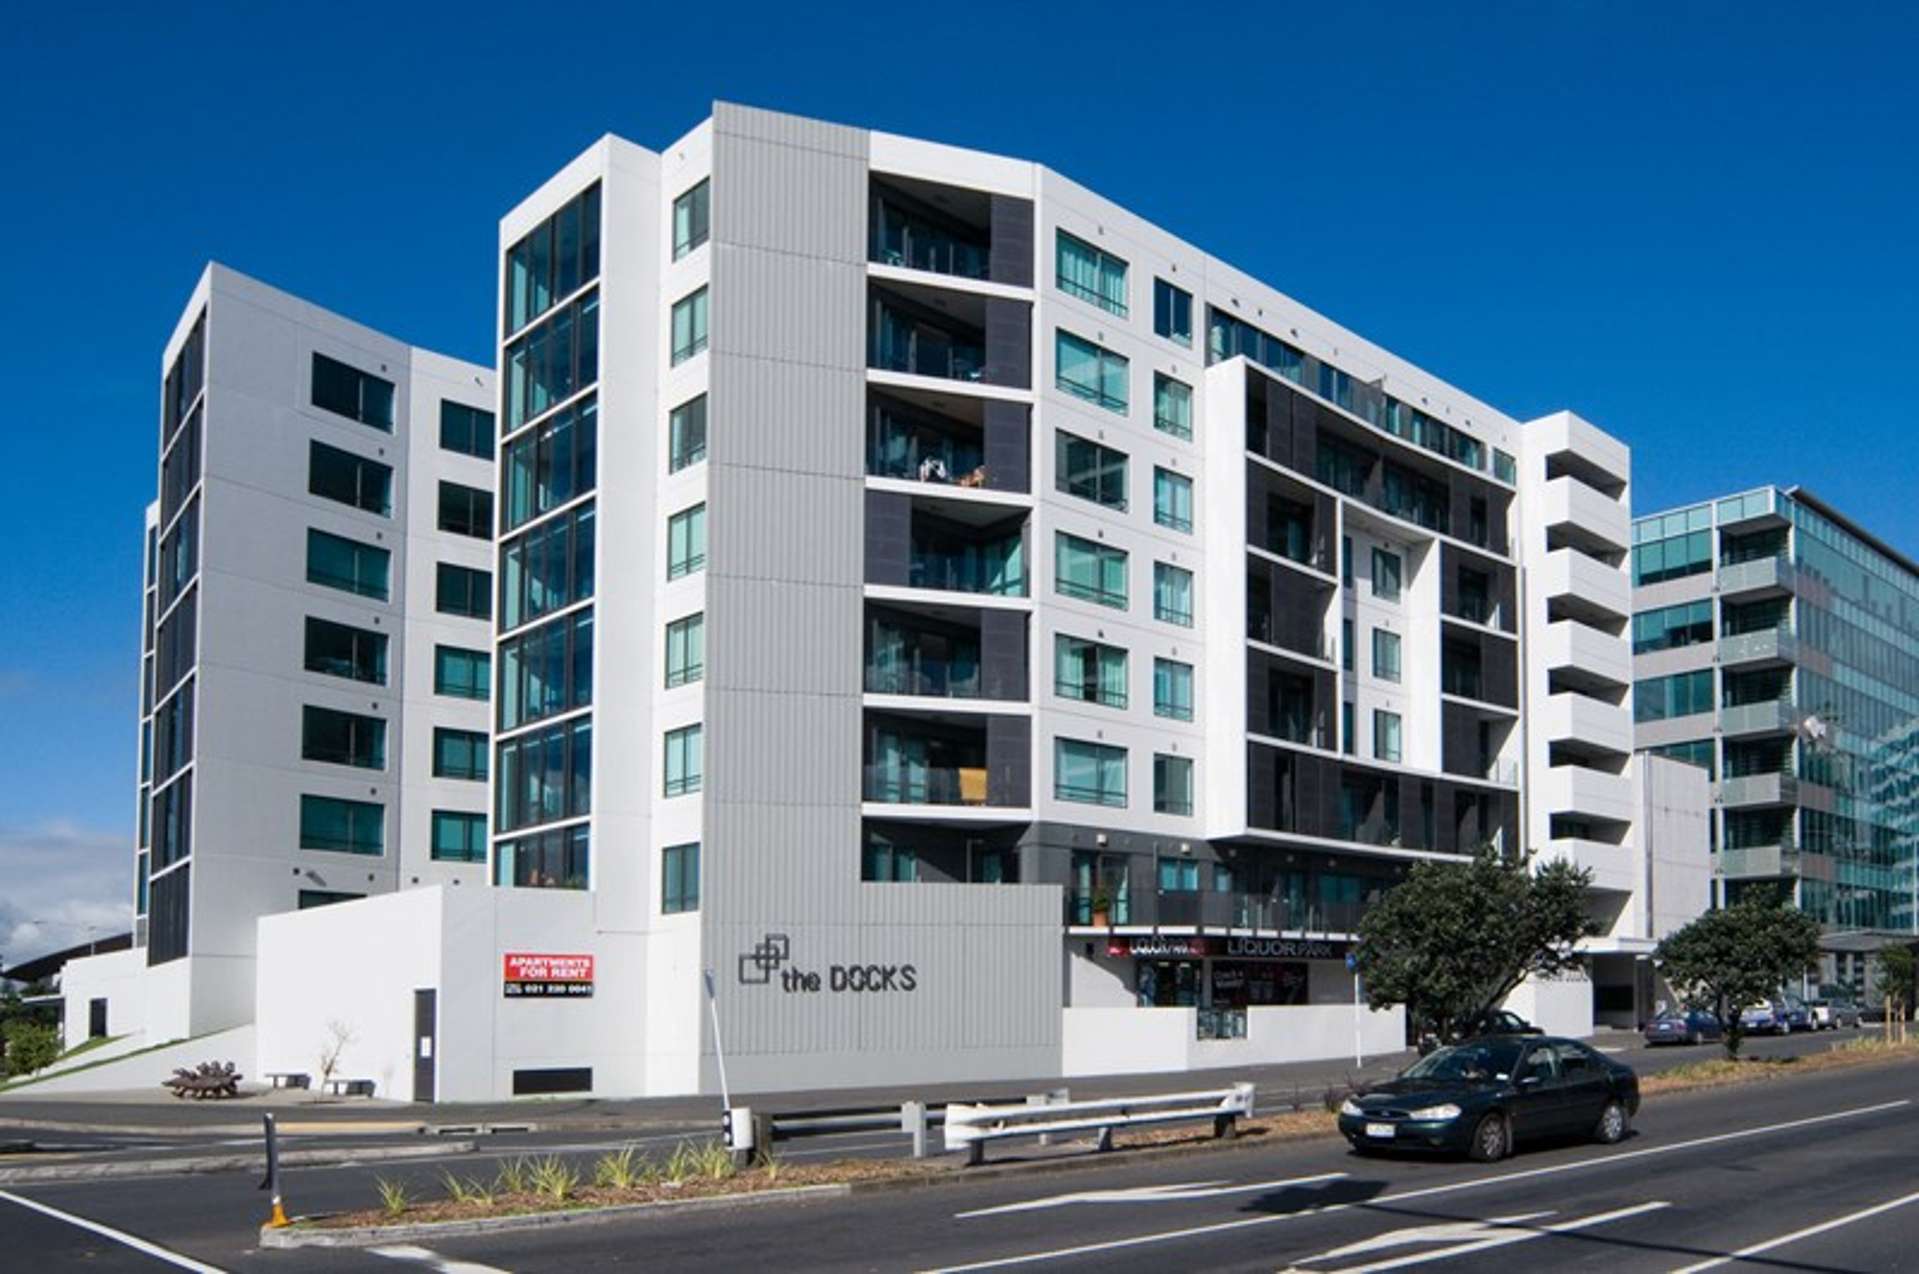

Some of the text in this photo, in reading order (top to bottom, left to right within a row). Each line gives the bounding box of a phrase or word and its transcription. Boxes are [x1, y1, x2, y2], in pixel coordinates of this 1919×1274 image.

[1227, 937, 1297, 956] LIQUOR
[510, 957, 590, 967] APARTMENTS
[520, 967, 587, 978] FOR RENT
[781, 964, 917, 992] the DOCKS
